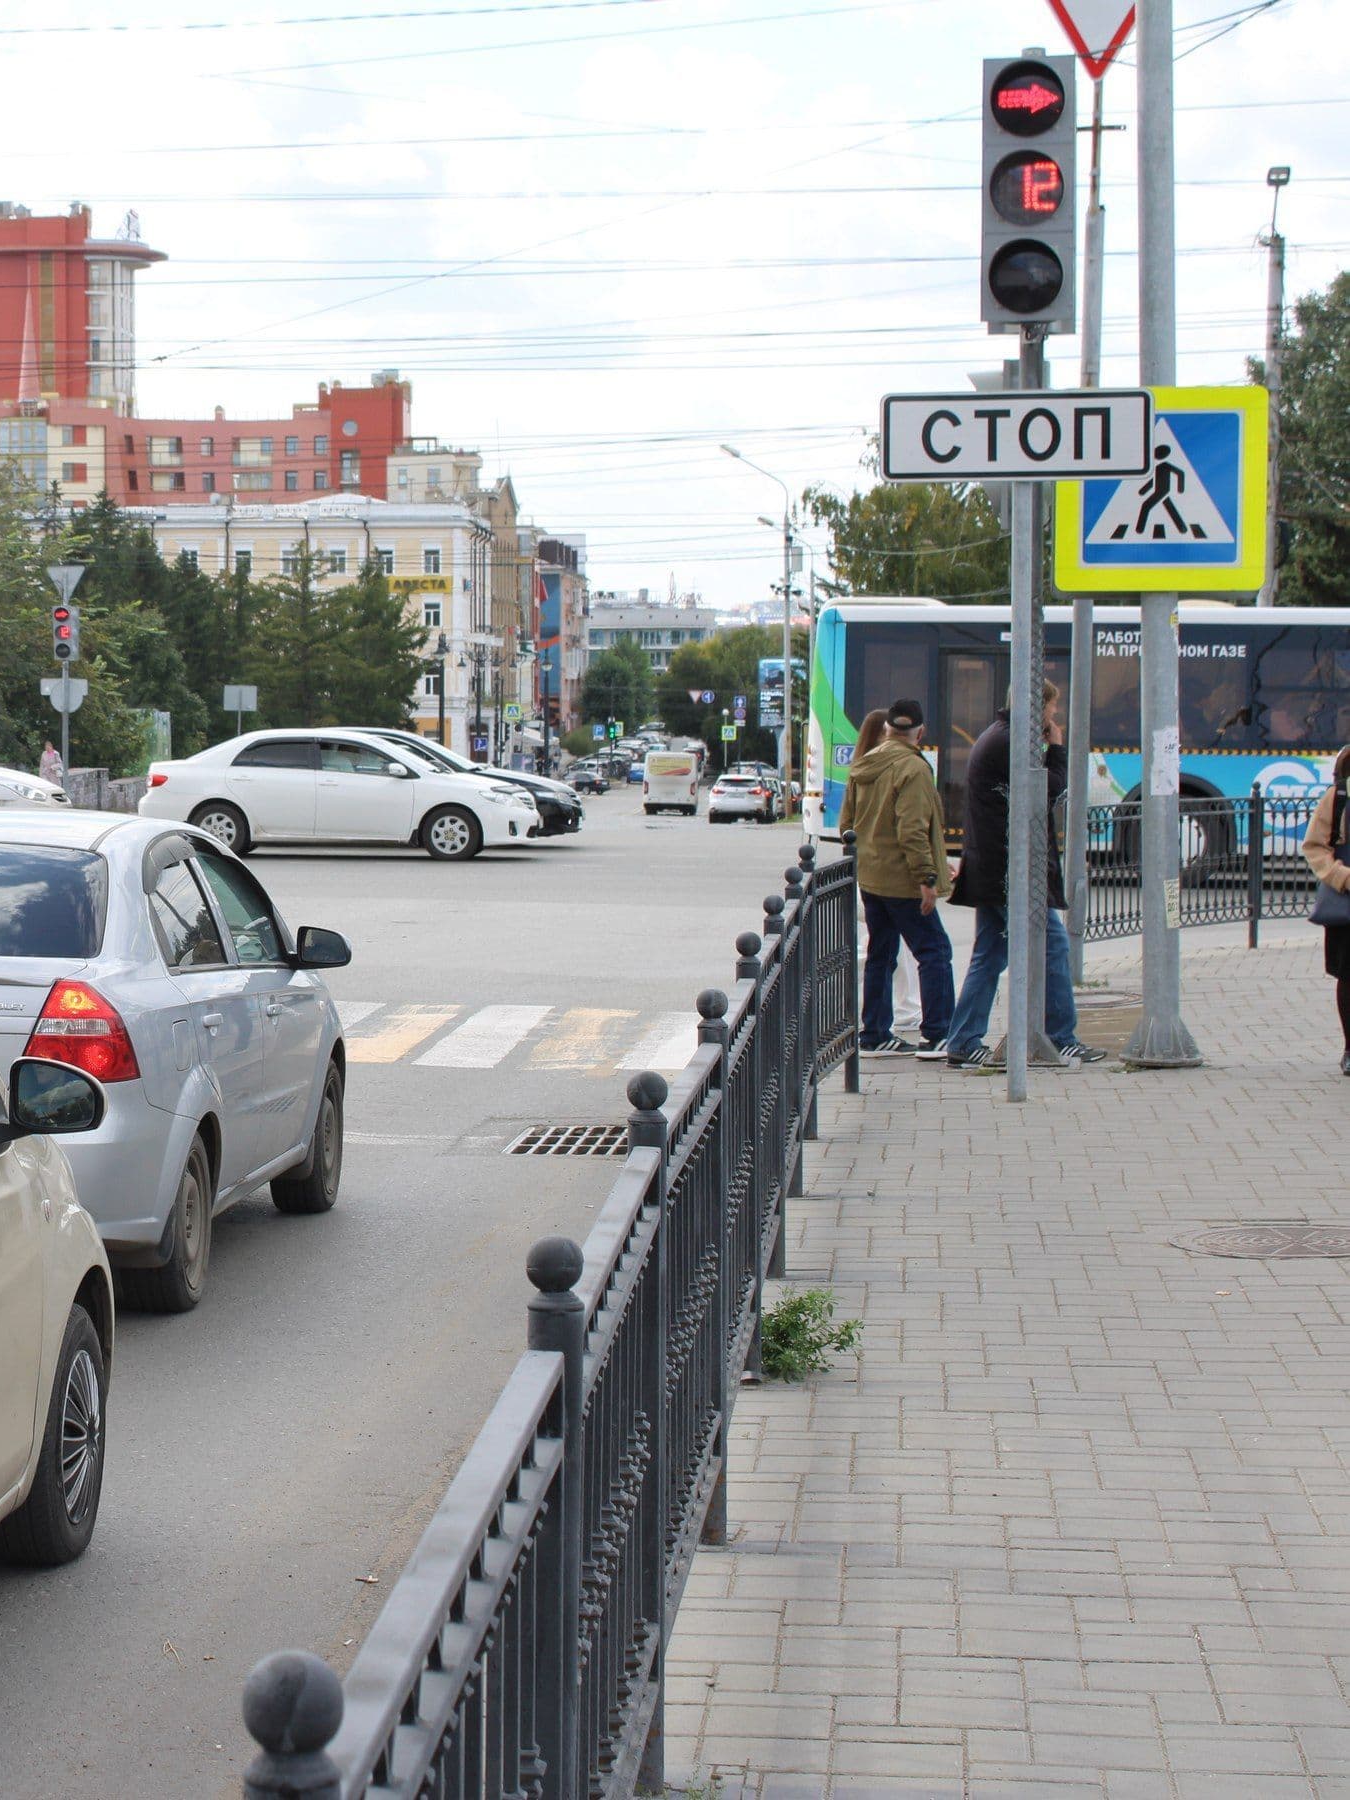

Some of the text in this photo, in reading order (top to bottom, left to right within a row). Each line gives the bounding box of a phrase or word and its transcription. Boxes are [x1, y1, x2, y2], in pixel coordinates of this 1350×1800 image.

[1023, 161, 1058, 211] 12
[921, 407, 1111, 463] СТОП
[1097, 631, 1141, 644] РАБОТ
[1097, 645, 1116, 657] НА
[1211, 645, 1247, 658] ГАЗЕ
